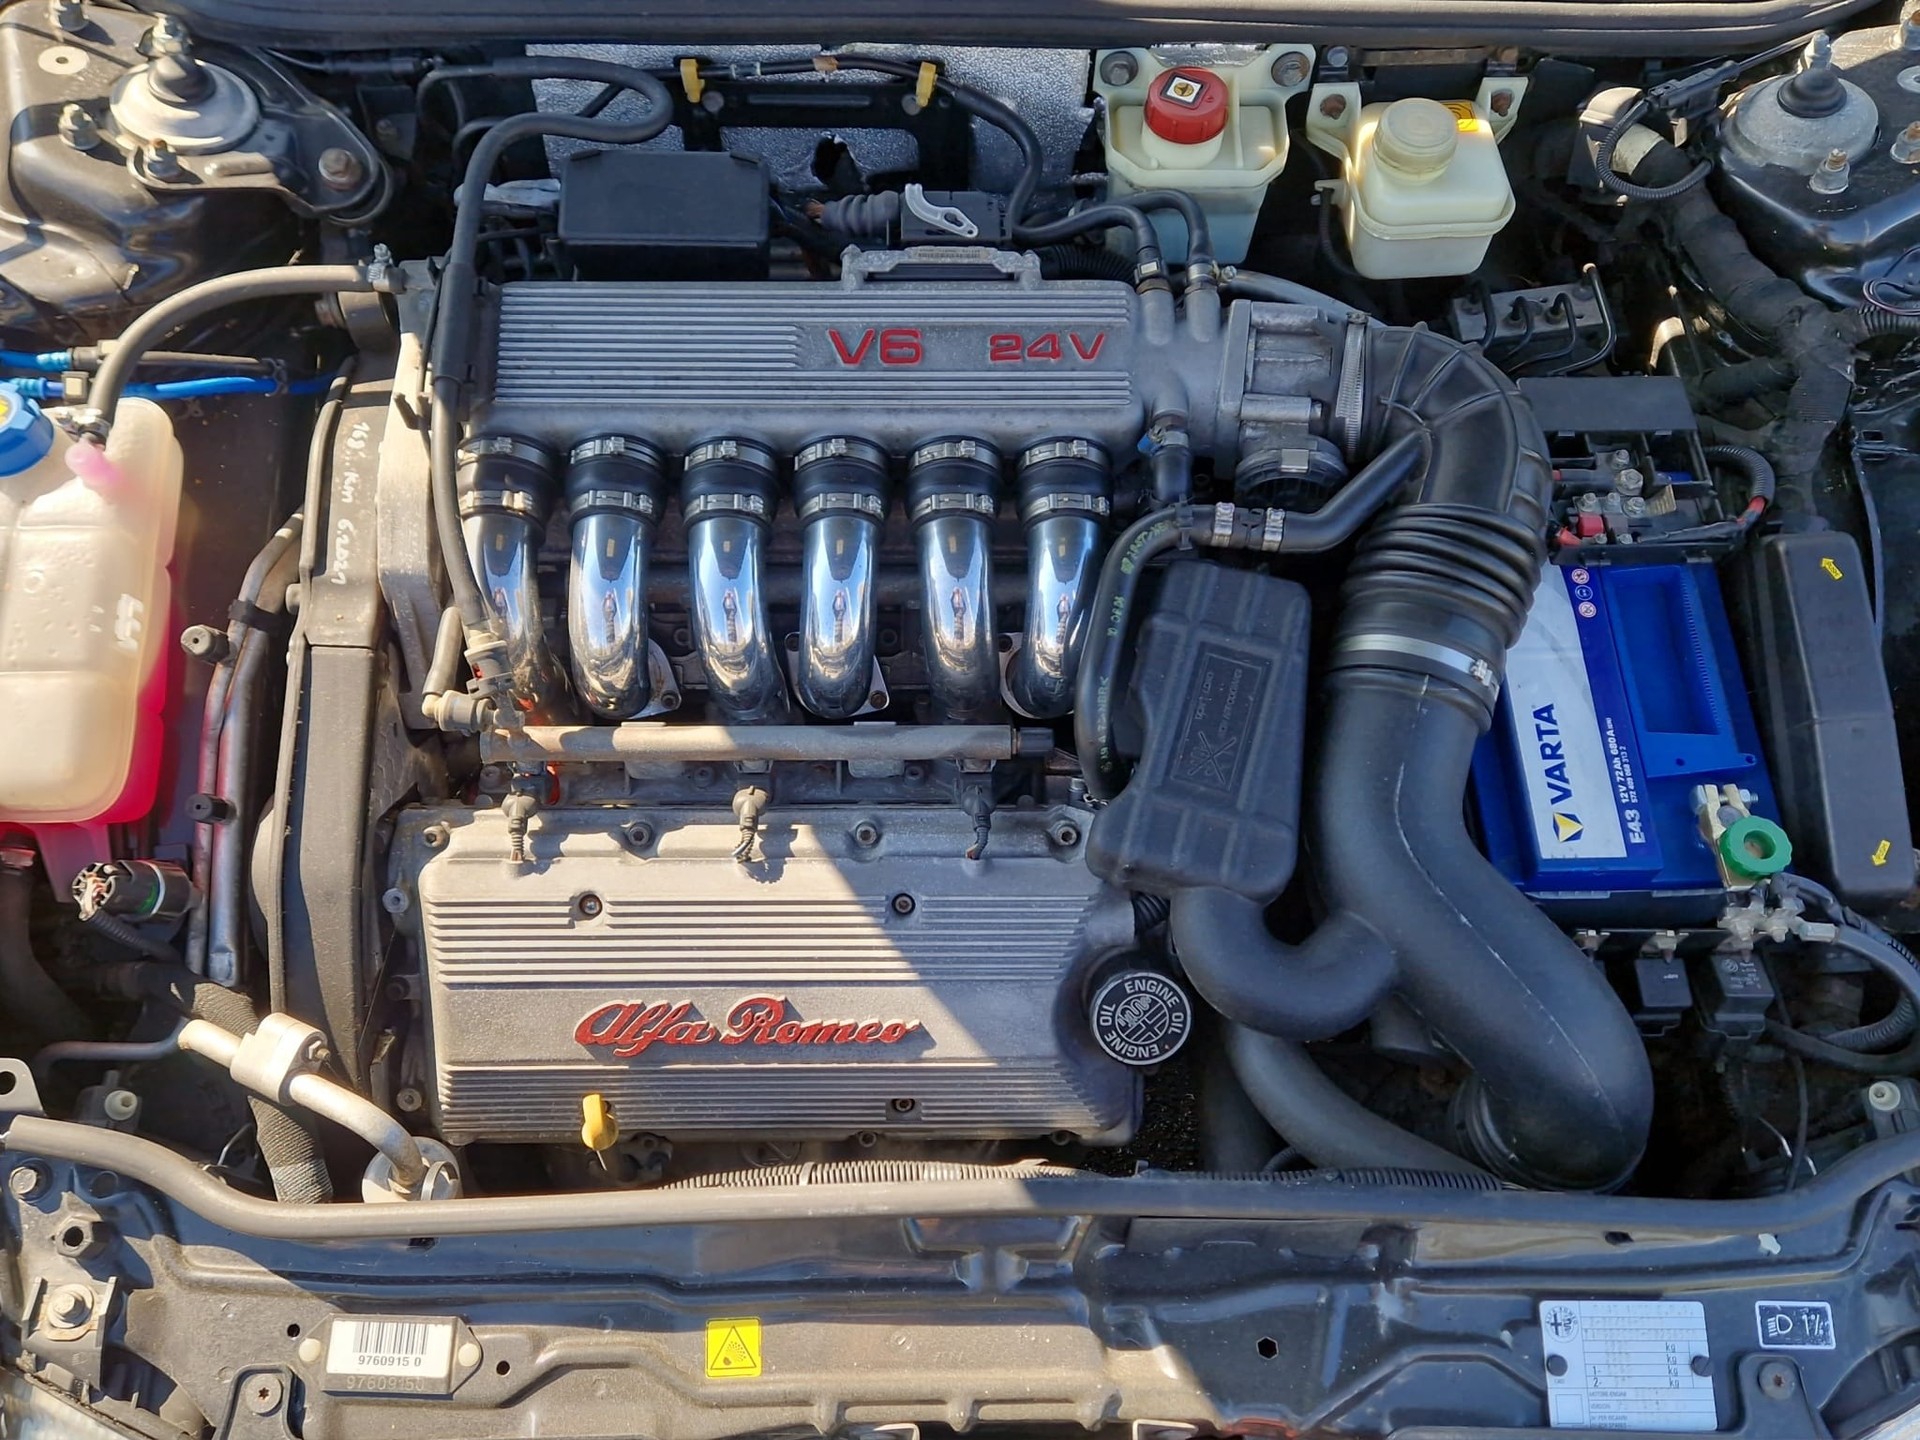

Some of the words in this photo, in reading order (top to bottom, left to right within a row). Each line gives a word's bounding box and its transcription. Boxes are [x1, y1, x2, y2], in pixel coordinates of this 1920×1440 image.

[827, 328, 922, 366] V6
[989, 333, 1105, 362] 24V
[1533, 703, 1573, 806] VARTA
[1613, 757, 1625, 783] 72Ah
[1617, 785, 1628, 804] 12V
[1625, 809, 1646, 844] E43
[1124, 979, 1179, 1008] ENGINE
[573, 999, 716, 1057] Alfa
[719, 993, 921, 1045] Romeo
[1100, 1003, 1116, 1026] OIL
[1168, 1012, 1184, 1034] OIL
[1104, 1030, 1160, 1058] ENGINE
[1665, 1342, 1676, 1354] kg
[358, 1355, 409, 1367] 9760915
[414, 1357, 422, 1367] 0
[1666, 1354, 1677, 1366] kg
[1668, 1365, 1678, 1377] kg
[347, 1375, 425, 1391] 97609150
[1669, 1377, 1680, 1389] kg
